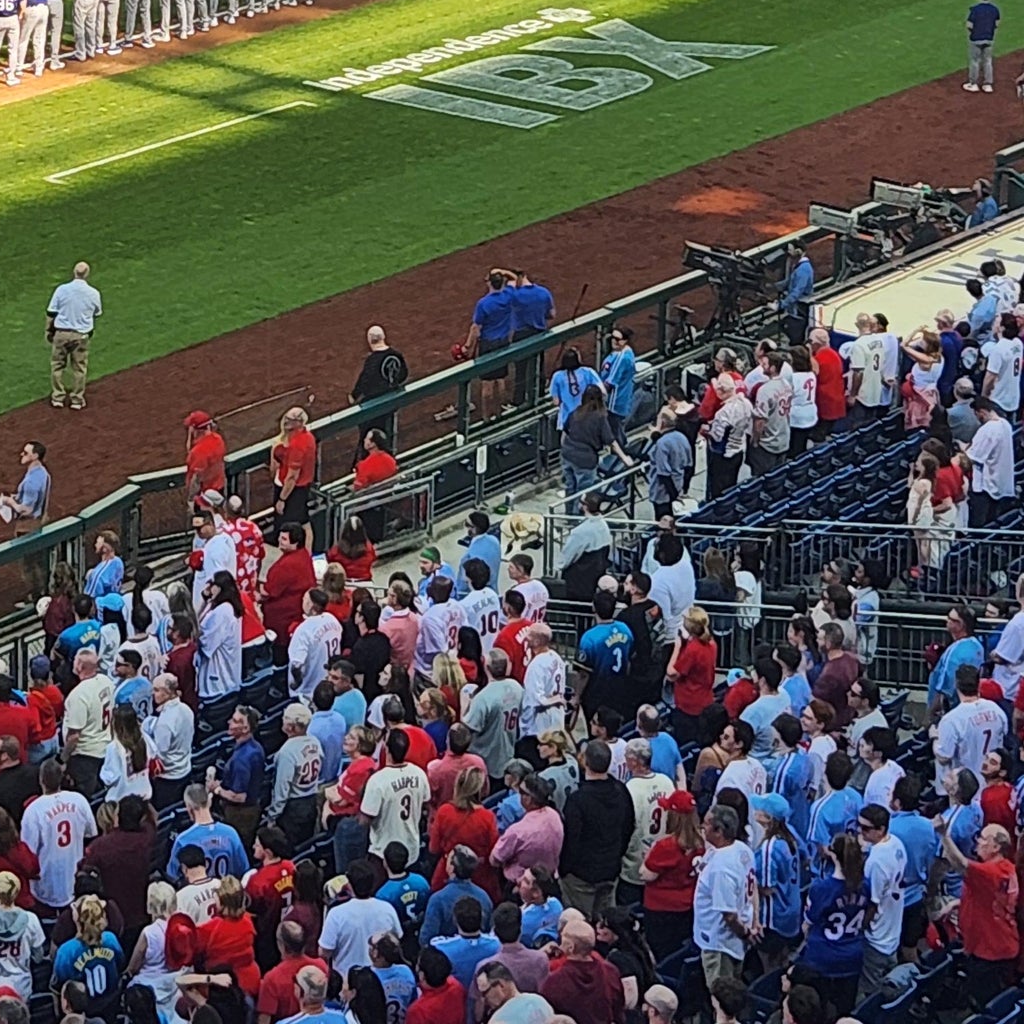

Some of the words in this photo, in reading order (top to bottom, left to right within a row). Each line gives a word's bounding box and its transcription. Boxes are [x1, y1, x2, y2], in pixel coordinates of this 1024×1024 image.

[302, 18, 554, 92] Independence
[362, 18, 778, 130] IBX
[480, 610, 499, 637] 10
[982, 728, 992, 756] 7
[399, 794, 412, 822] 3
[57, 819, 73, 848] 3
[824, 909, 866, 941] 34
[84, 964, 107, 997] 10
